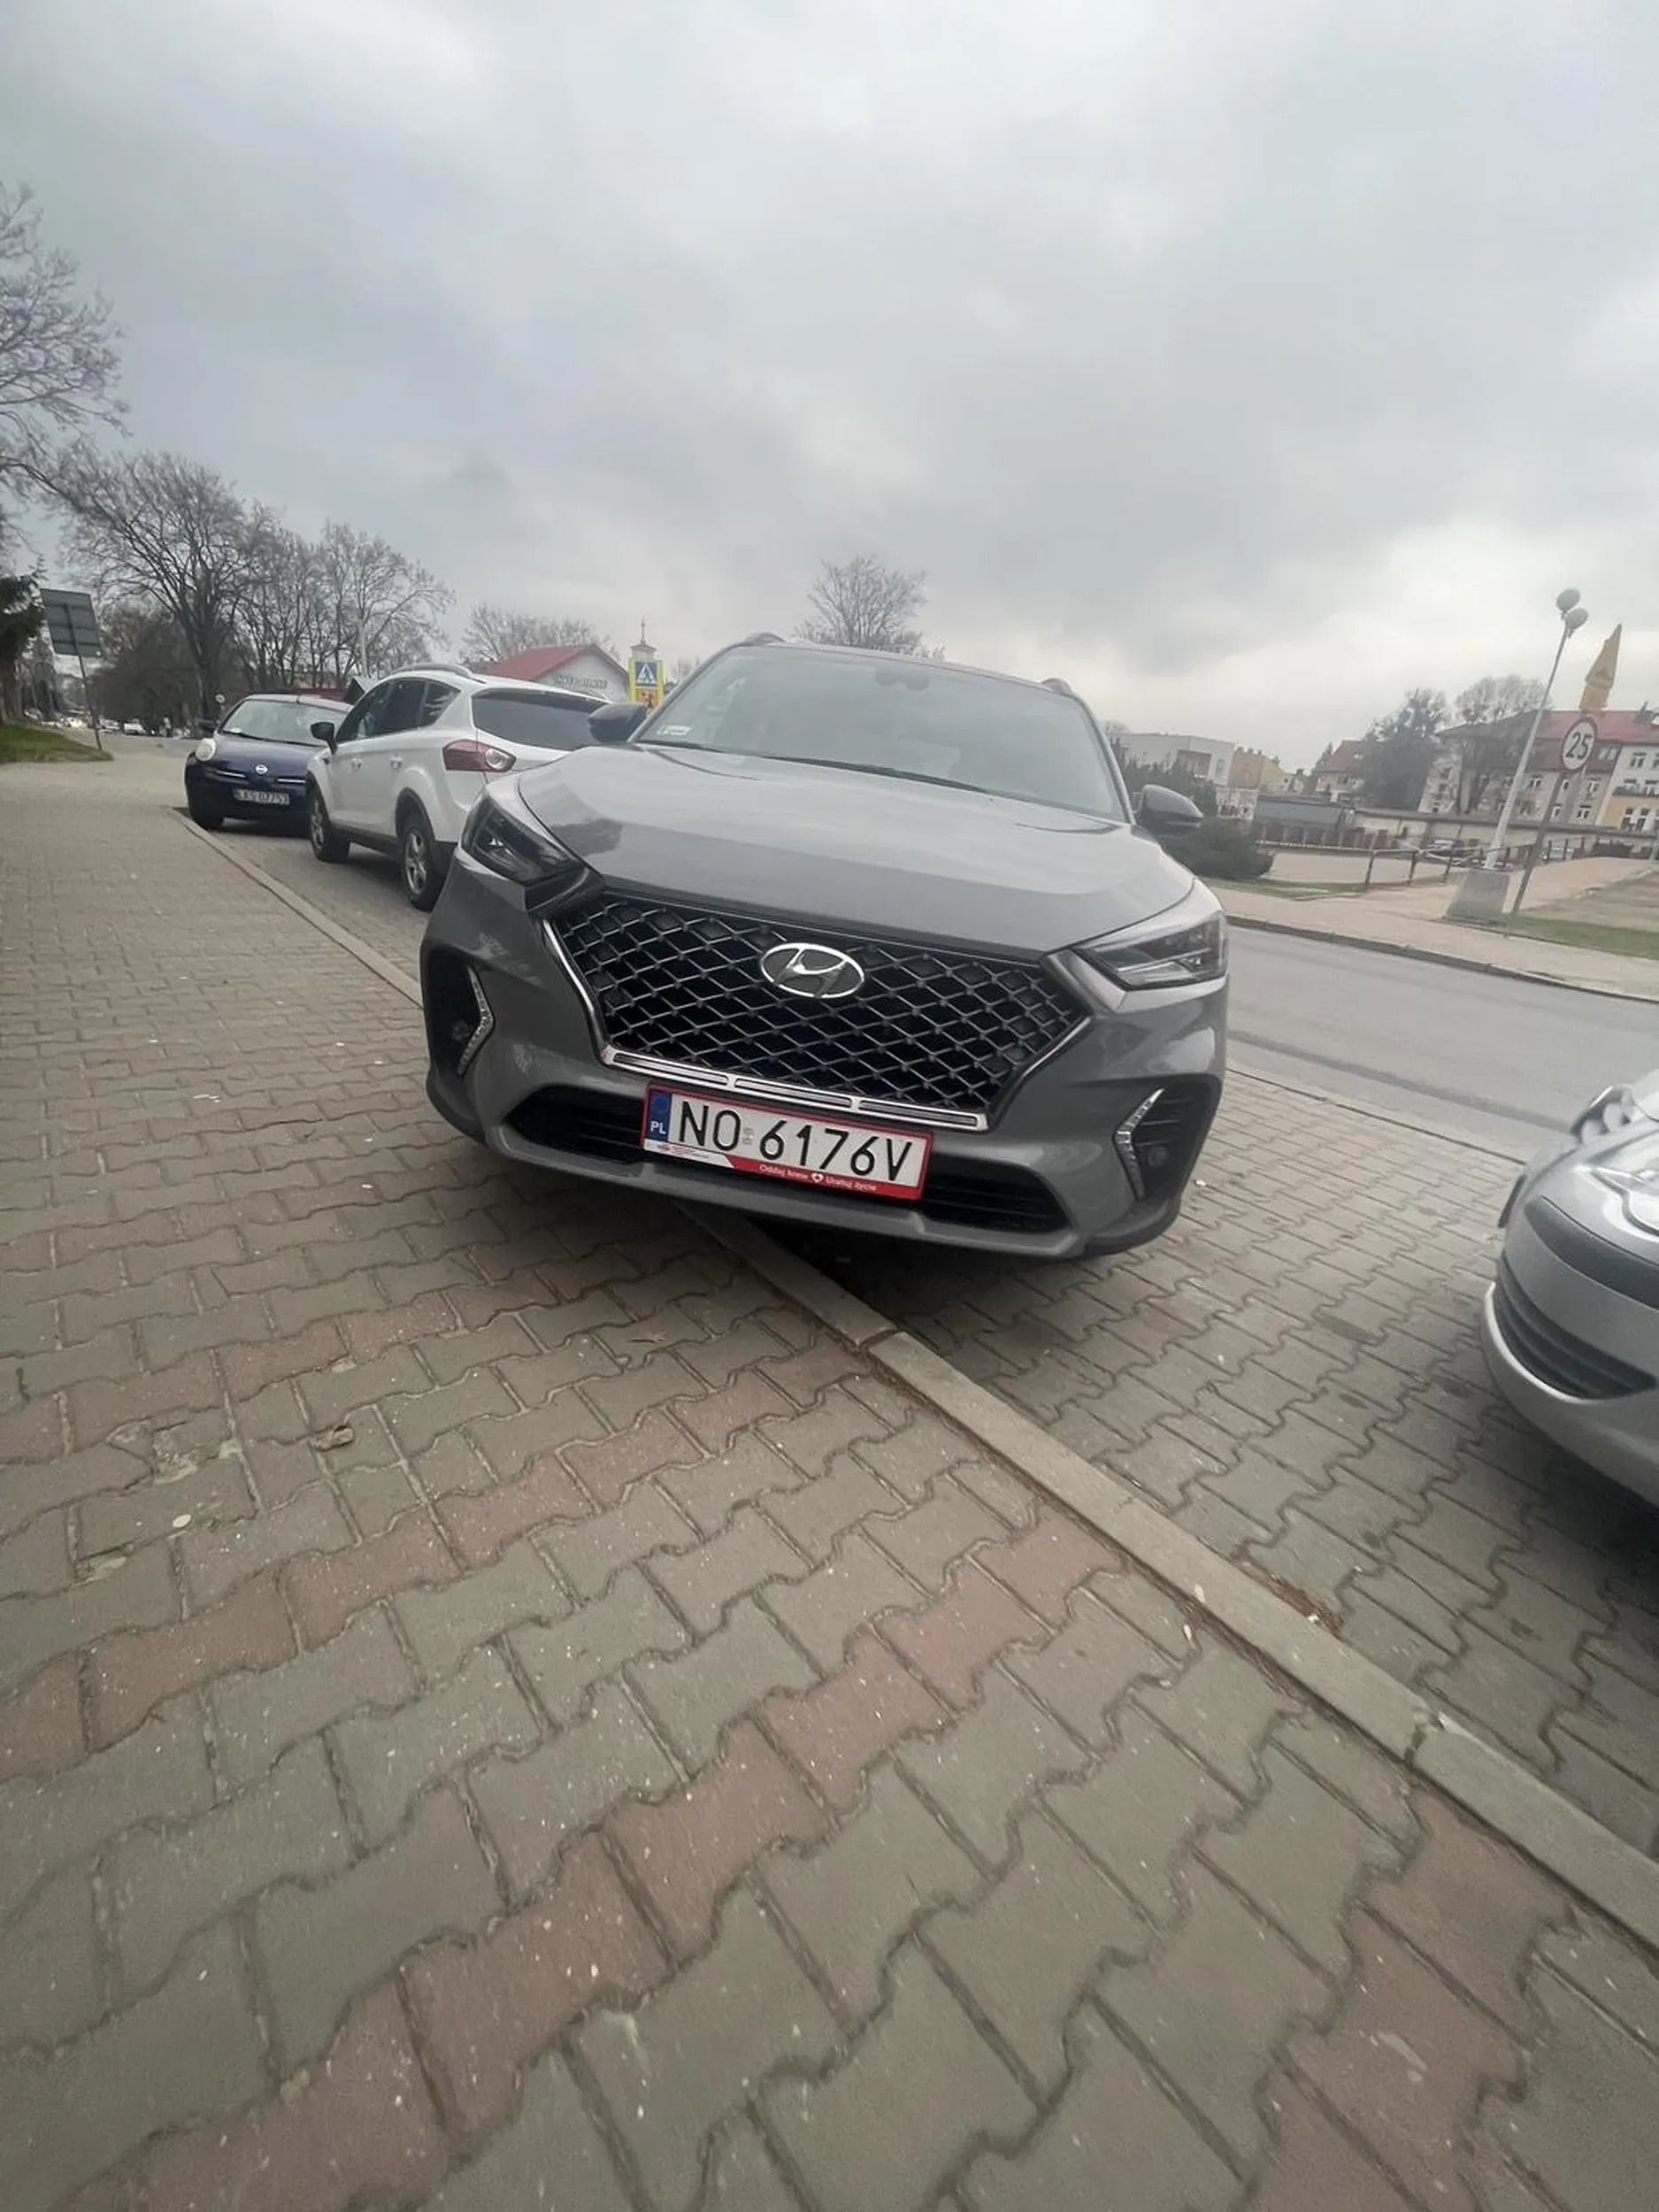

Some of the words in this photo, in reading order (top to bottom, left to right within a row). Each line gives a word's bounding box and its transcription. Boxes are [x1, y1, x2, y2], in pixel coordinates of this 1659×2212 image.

[1564, 731, 1593, 759] 25
[650, 1121, 667, 1134] PL
[679, 1102, 741, 1151] NO
[759, 1119, 912, 1181] 6176V
